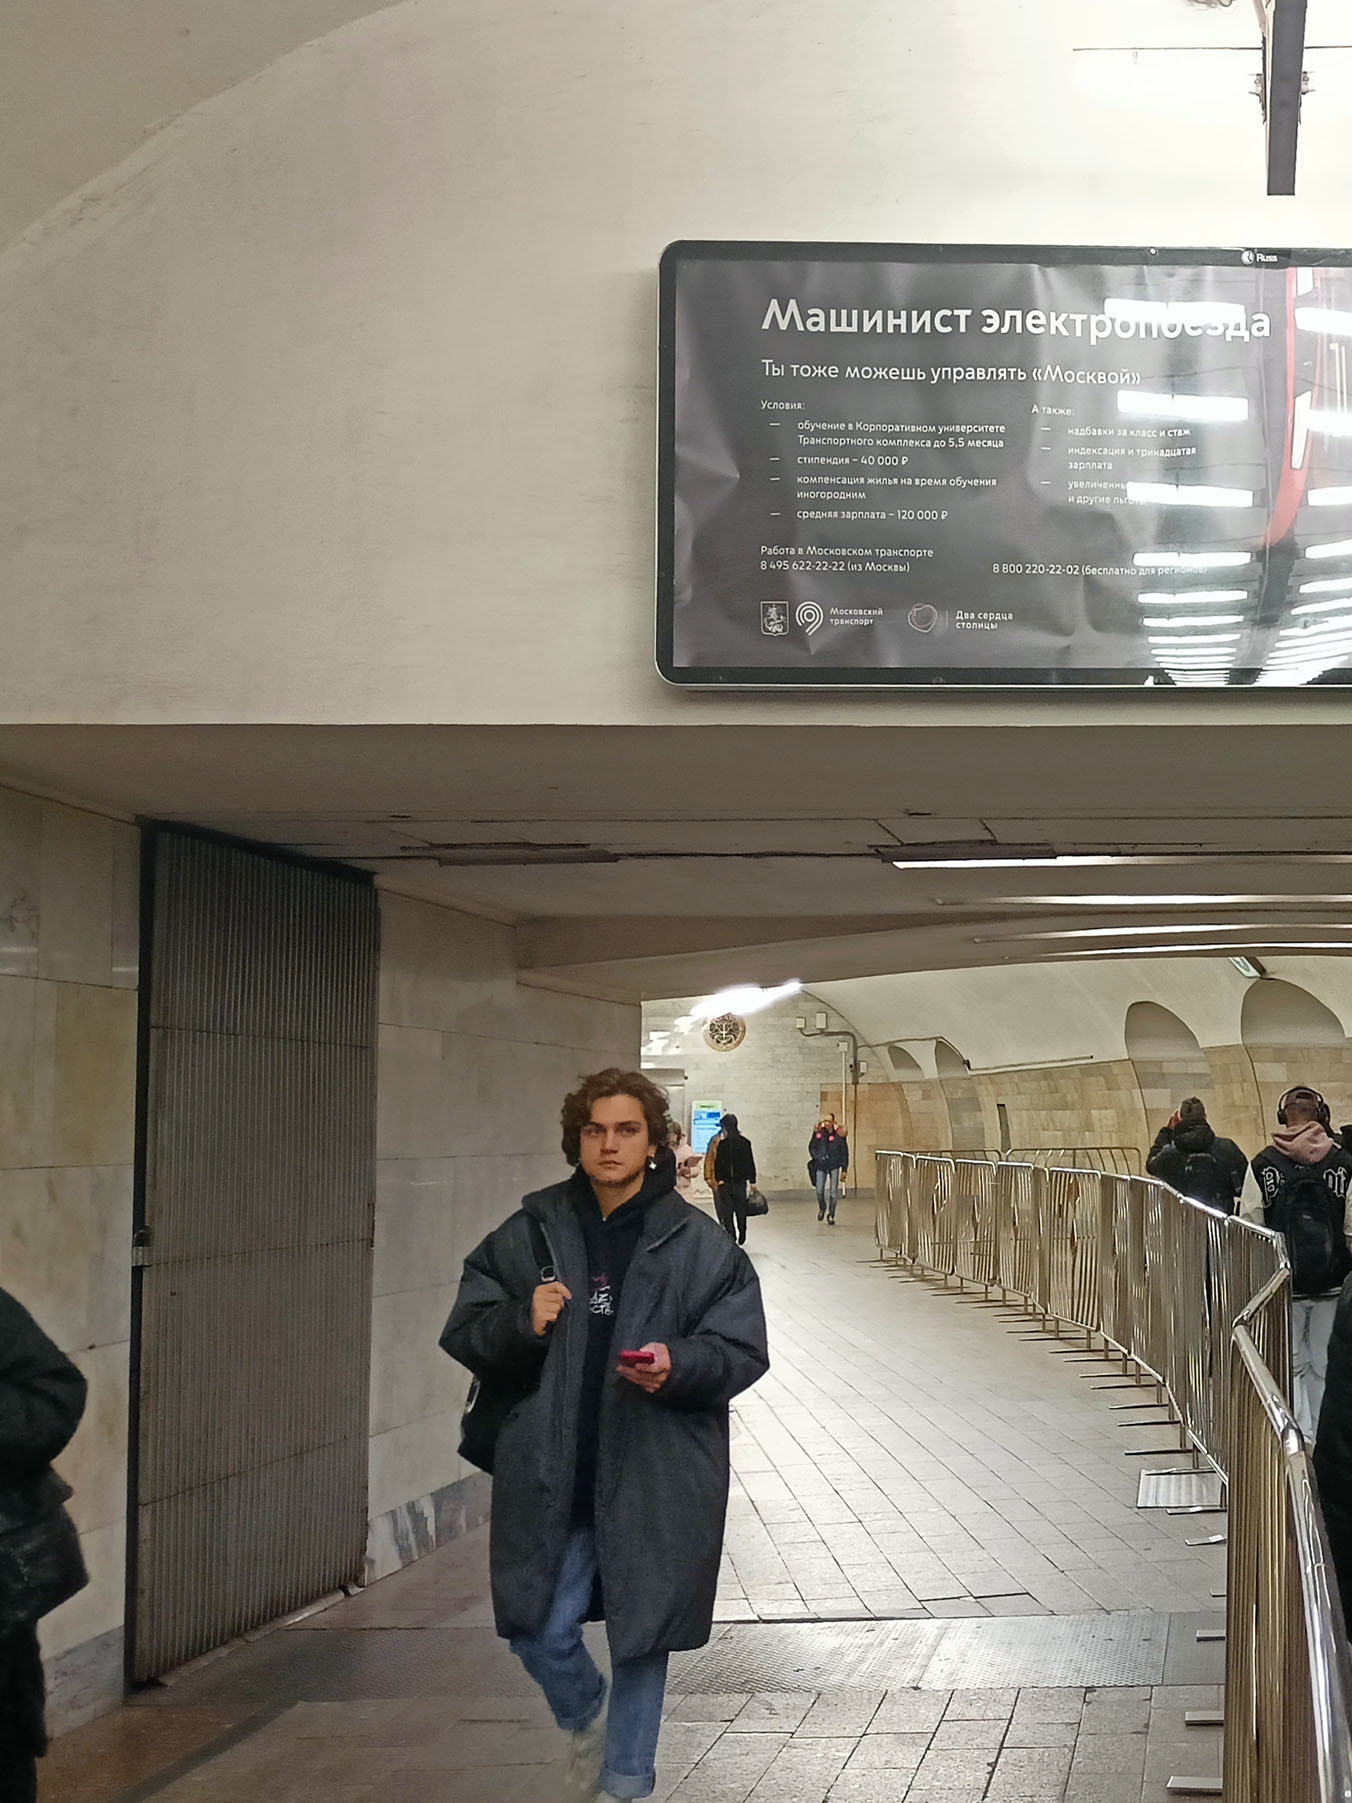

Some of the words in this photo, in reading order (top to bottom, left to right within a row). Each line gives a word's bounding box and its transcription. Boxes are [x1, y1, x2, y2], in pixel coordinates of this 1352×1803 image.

[1256, 253, 1278, 262] Russ
[761, 298, 973, 333] Машинист
[761, 359, 785, 377] Ты
[790, 364, 839, 379] тоже
[845, 366, 926, 381] можешь
[931, 367, 1027, 384] управлять
[1032, 365, 1141, 385] «Москвой»
[760, 400, 806, 411] Условия:
[1031, 404, 1040, 415] А
[1042, 407, 1075, 416] также:
[797, 422, 846, 433] обучение
[855, 421, 936, 434] Корпоративном
[938, 424, 1006, 435] университете
[1068, 426, 1114, 437] надбавки
[1130, 429, 1157, 437] класс
[1167, 429, 1191, 437] стаж
[798, 435, 874, 449] Транспортного
[876, 438, 931, 449] комплекса
[933, 438, 946, 449] до
[948, 437, 964, 449] 5,5
[967, 438, 1004, 449] месяца
[1068, 446, 1126, 457] индексация
[1136, 447, 1197, 458] тринадцатая
[797, 456, 850, 466] стипендия
[861, 455, 875, 466] 40
[877, 455, 899, 466] 000
[1068, 461, 1113, 472] зарплата
[797, 476, 864, 487] компенсация
[867, 477, 898, 486] жилья
[901, 477, 913, 486] на
[915, 478, 947, 488] время
[949, 475, 997, 488] обучения
[797, 491, 866, 501] иногородним
[1076, 496, 1110, 505] другие
[797, 510, 838, 521] средняя
[841, 511, 886, 521] зарплата
[897, 510, 914, 521] 120
[917, 510, 939, 521] 000
[760, 546, 795, 556] Работа
[806, 546, 873, 557] Московском
[876, 549, 933, 559] транспорте
[760, 561, 767, 570] 8
[770, 561, 789, 571] 495
[792, 561, 845, 571] 622-22-22
[847, 561, 862, 572] (из
[865, 562, 910, 573] Москвы)
[992, 563, 1000, 574] 8
[1002, 563, 1023, 574] 800
[1025, 564, 1079, 575] 220-22-02
[1081, 565, 1137, 576] (бесплатно
[830, 607, 883, 616] Московский
[956, 611, 975, 621] Два
[978, 612, 1013, 621] сердца
[830, 617, 873, 625] транспорт
[956, 621, 998, 630] столицы
